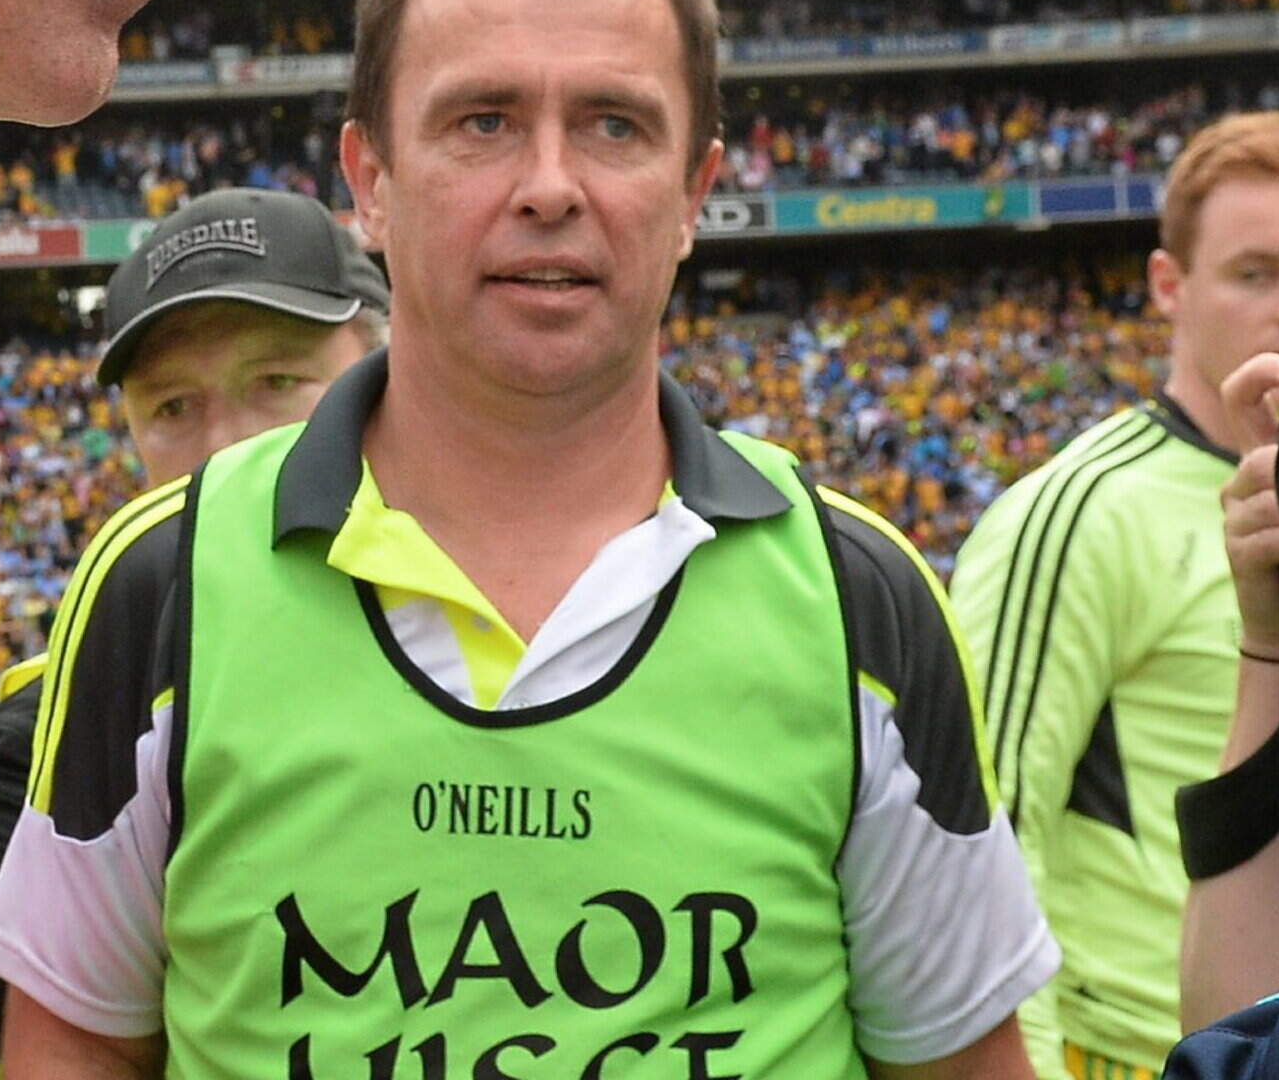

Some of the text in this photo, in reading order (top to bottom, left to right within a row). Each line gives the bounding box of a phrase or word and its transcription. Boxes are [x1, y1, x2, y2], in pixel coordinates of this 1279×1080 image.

[815, 193, 937, 225] Centra
[413, 781, 592, 839] O'NEILLS
[275, 888, 758, 1010] MAOR
